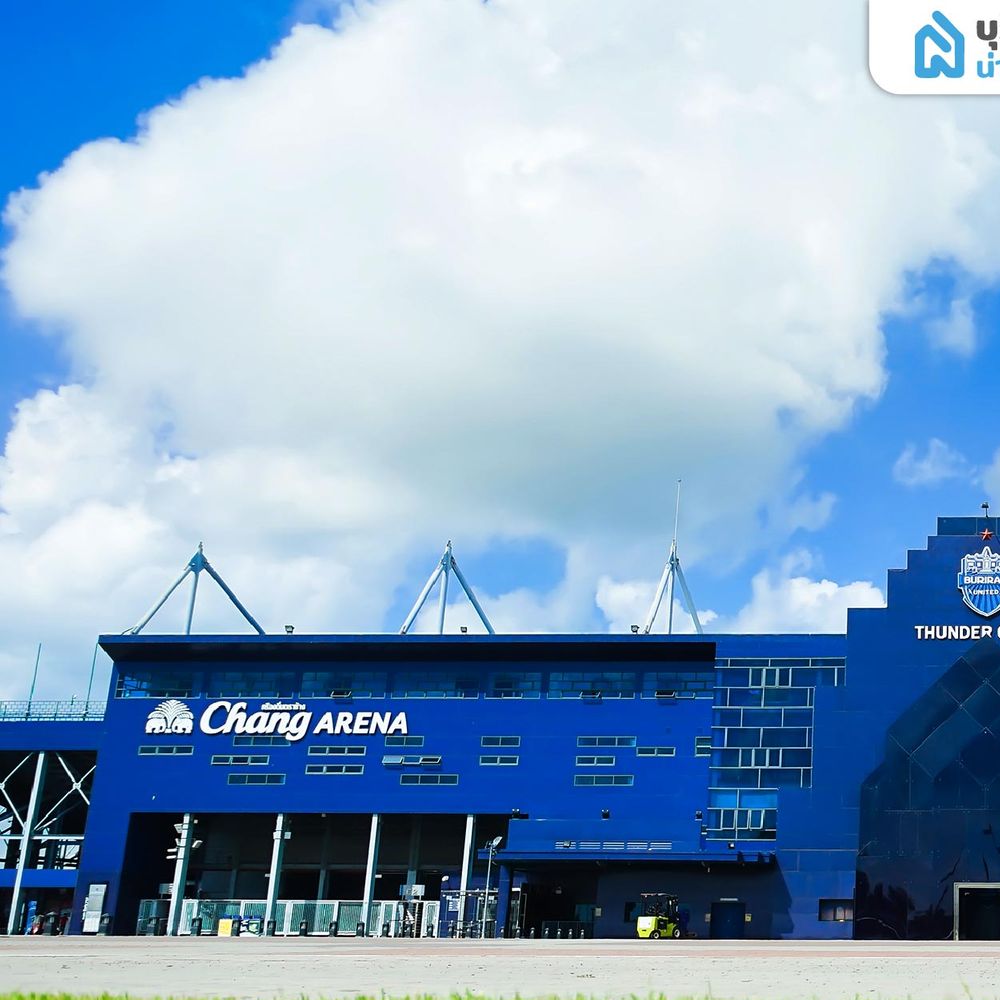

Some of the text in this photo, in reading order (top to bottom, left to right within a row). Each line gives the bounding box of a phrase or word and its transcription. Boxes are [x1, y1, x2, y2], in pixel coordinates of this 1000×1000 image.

[914, 625, 993, 640] THUNDER
[199, 700, 409, 741] Chang ARENA
